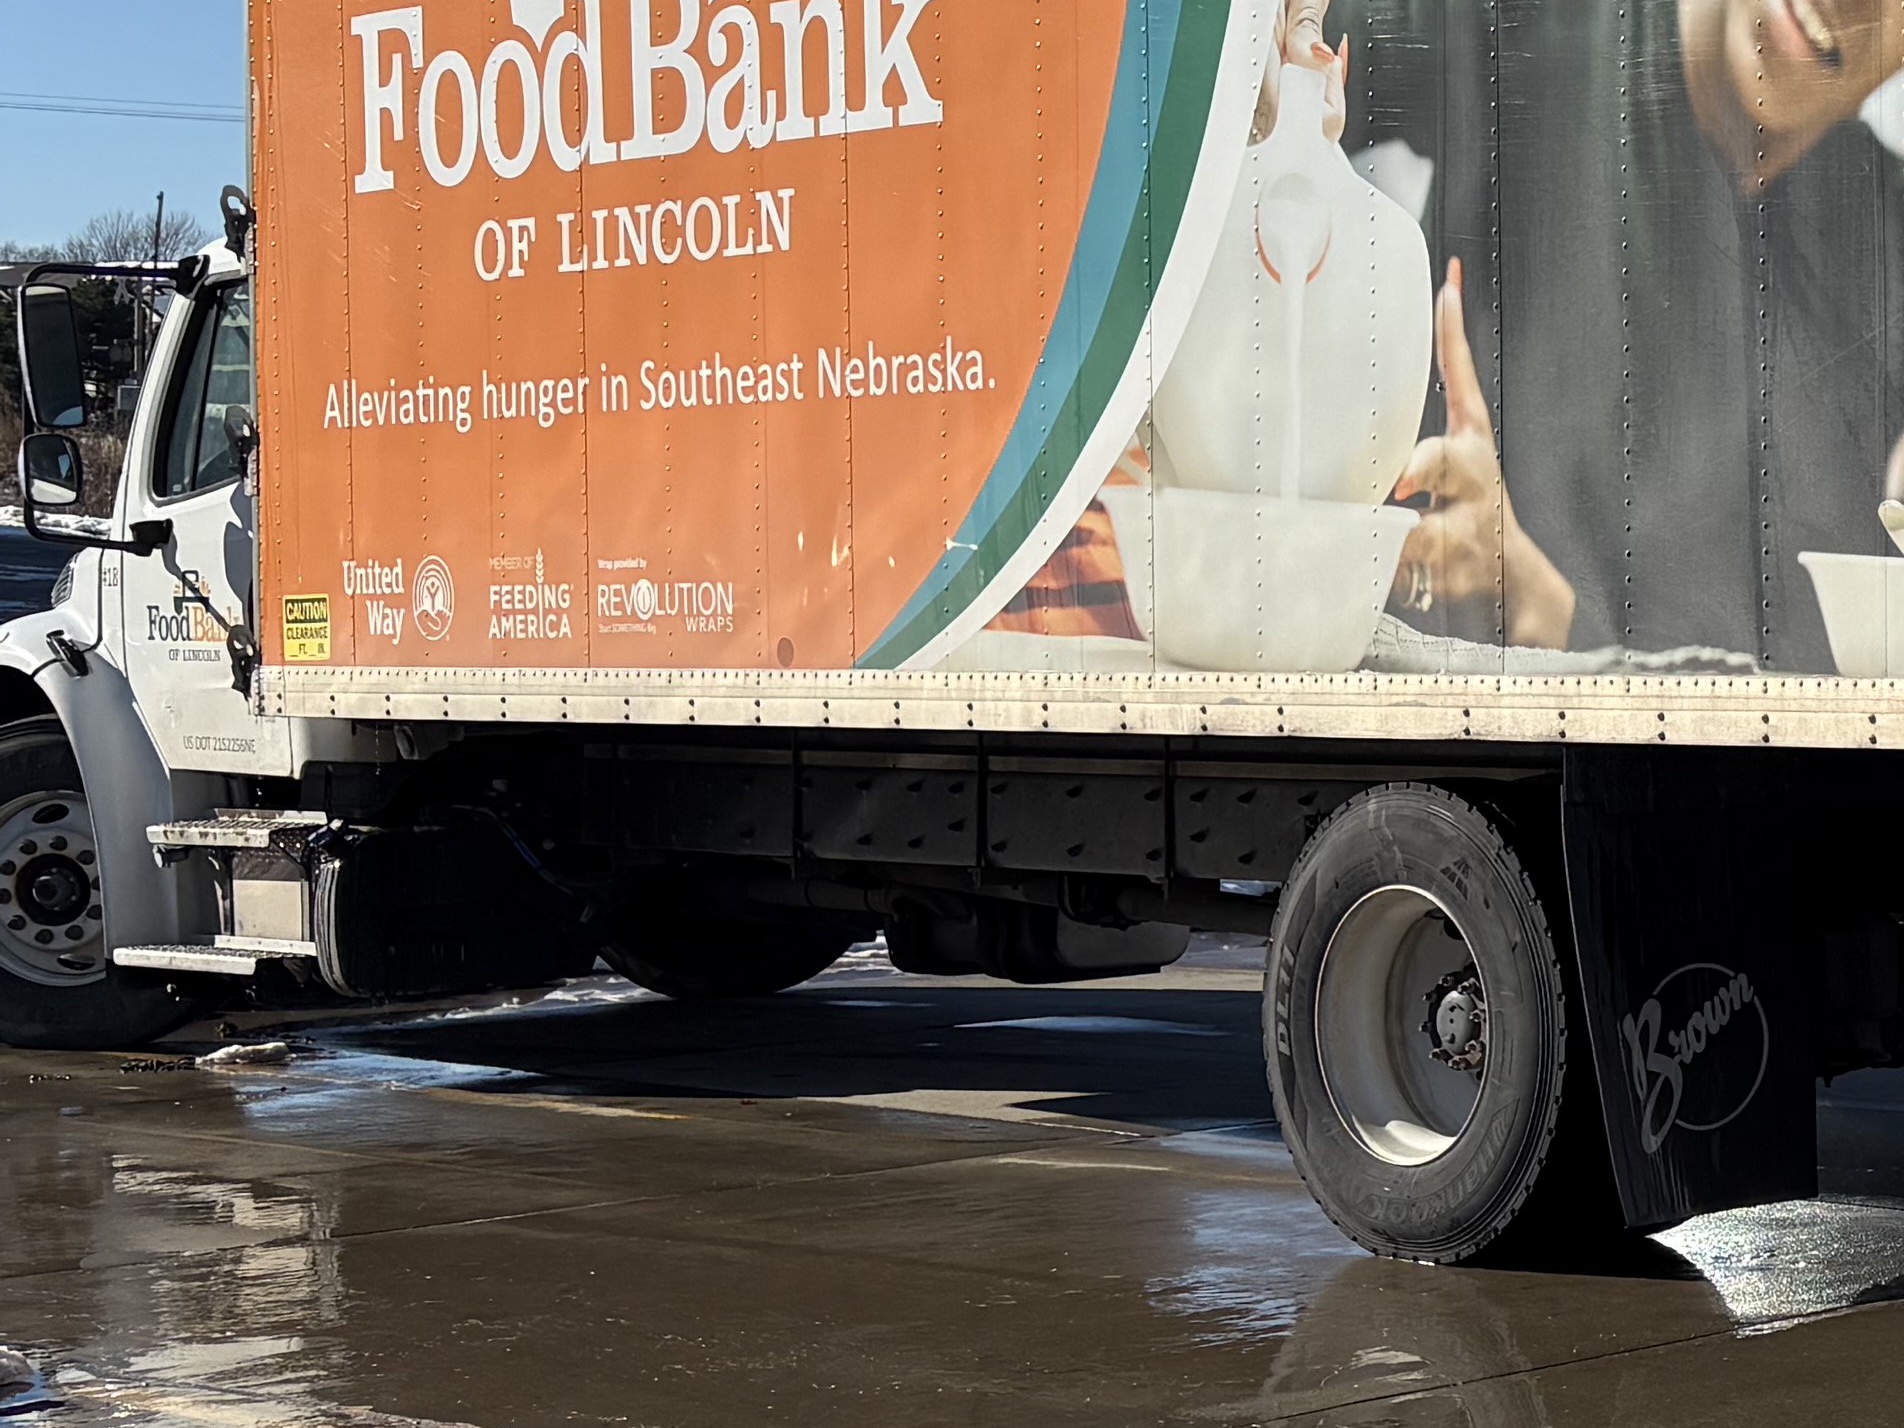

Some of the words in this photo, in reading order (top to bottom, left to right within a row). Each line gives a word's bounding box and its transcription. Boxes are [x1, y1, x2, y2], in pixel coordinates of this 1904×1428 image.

[474, 217, 536, 281] OF
[557, 188, 796, 274] LINCOLN
[323, 377, 472, 435] Alleviating
[482, 367, 589, 429] hunger
[600, 363, 628, 412] in
[640, 348, 804, 412] Southeast
[817, 335, 997, 399] Nebraska.
[342, 557, 405, 597] United
[490, 583, 571, 610] FEEDING
[286, 601, 327, 620] CAUTION
[597, 578, 734, 621] REVOLUTION
[366, 600, 406, 645] Way
[488, 614, 573, 639] AMERICA
[685, 616, 734, 633] WRAPS
